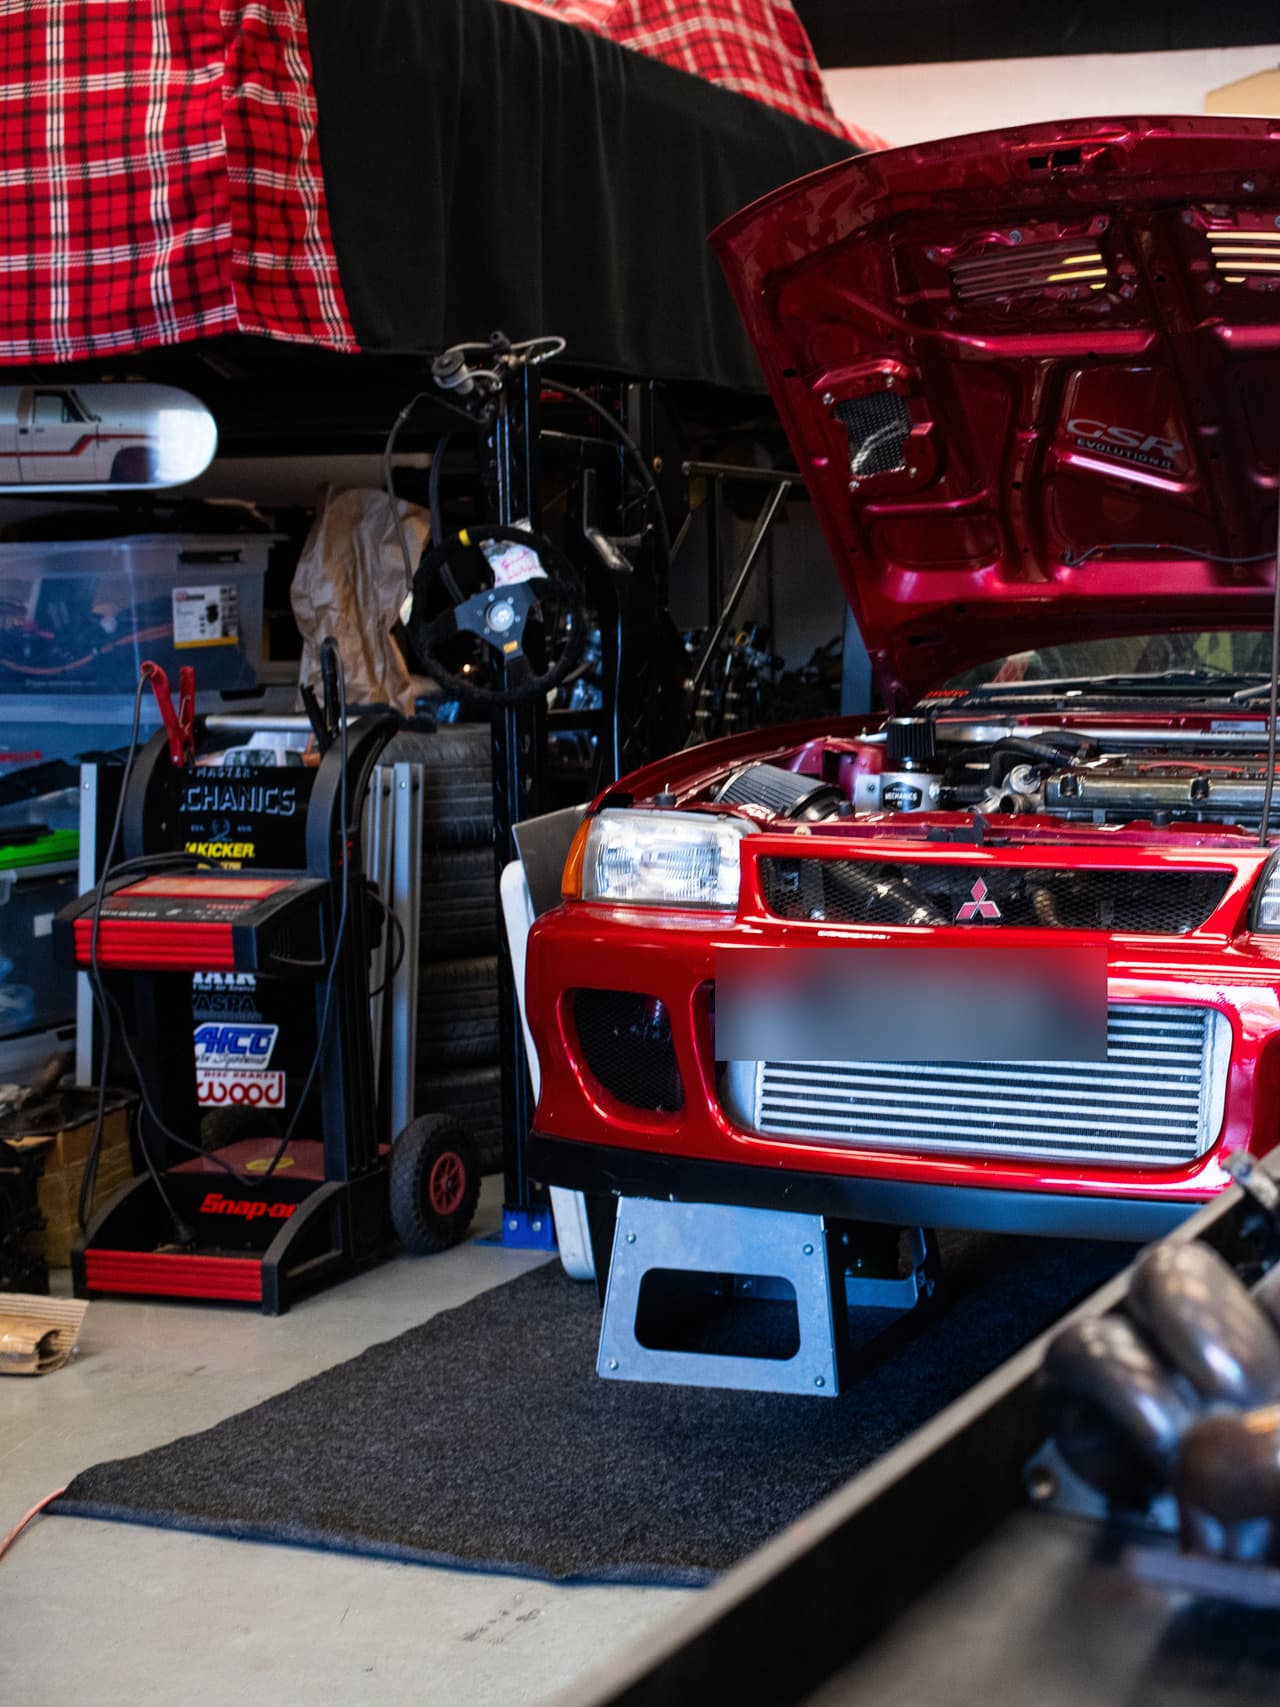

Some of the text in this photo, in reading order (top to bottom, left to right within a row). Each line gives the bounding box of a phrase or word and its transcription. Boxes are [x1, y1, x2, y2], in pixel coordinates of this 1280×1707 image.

[1067, 418, 1184, 458] GSR
[180, 786, 295, 816] CHANICS
[197, 842, 255, 858] KICKER
